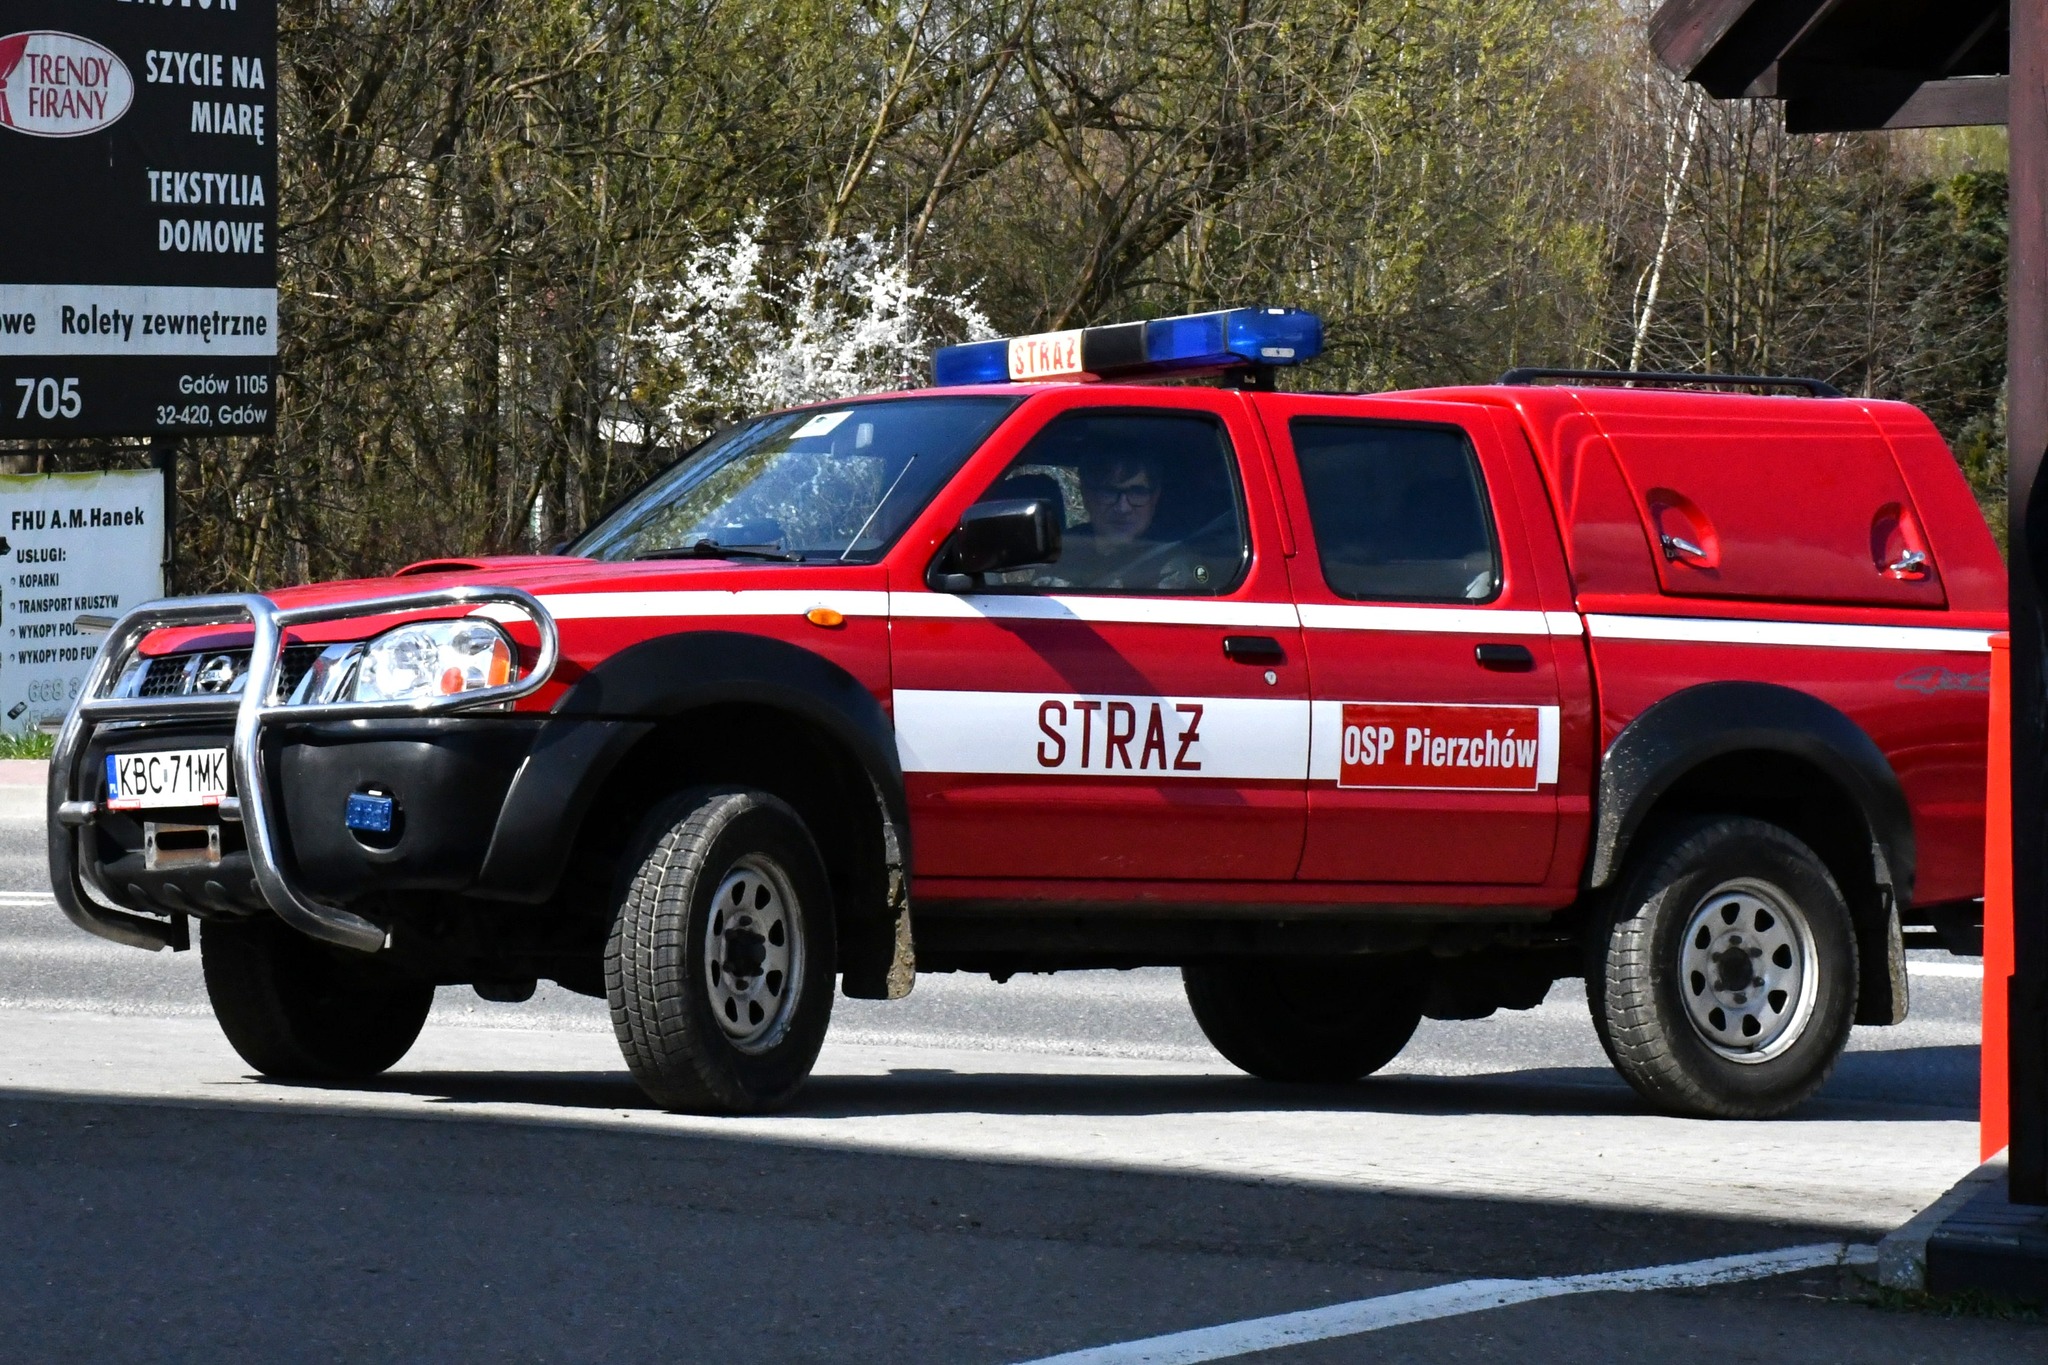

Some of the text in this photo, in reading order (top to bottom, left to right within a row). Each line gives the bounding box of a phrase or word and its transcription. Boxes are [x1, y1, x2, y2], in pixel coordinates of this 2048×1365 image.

[26, 53, 113, 88] TRENDY
[145, 49, 265, 90] SZYCIE NA
[28, 87, 109, 120] FIRANY
[190, 101, 265, 146] MIARĘ
[147, 170, 265, 207] TEKSTYLIA
[158, 219, 265, 254] DOMOWE
[61, 304, 134, 342] Rolety
[142, 310, 268, 343] zewnętrzne
[15, 377, 82, 419] 705
[179, 373, 268, 394] Gdów 1105
[156, 403, 267, 427] 32-420, Gdów
[12, 510, 46, 531] FHU
[16, 548, 67, 563] USŁUGI:
[19, 572, 59, 588] KOPARKI
[19, 595, 119, 614] TRANSPORT KRUSZYW
[19, 623, 57, 639] WYKOPY
[18, 649, 57, 664] WYKOPY
[59, 647, 79, 662] POD
[1344, 725, 1537, 768] OSP Pierzchów
